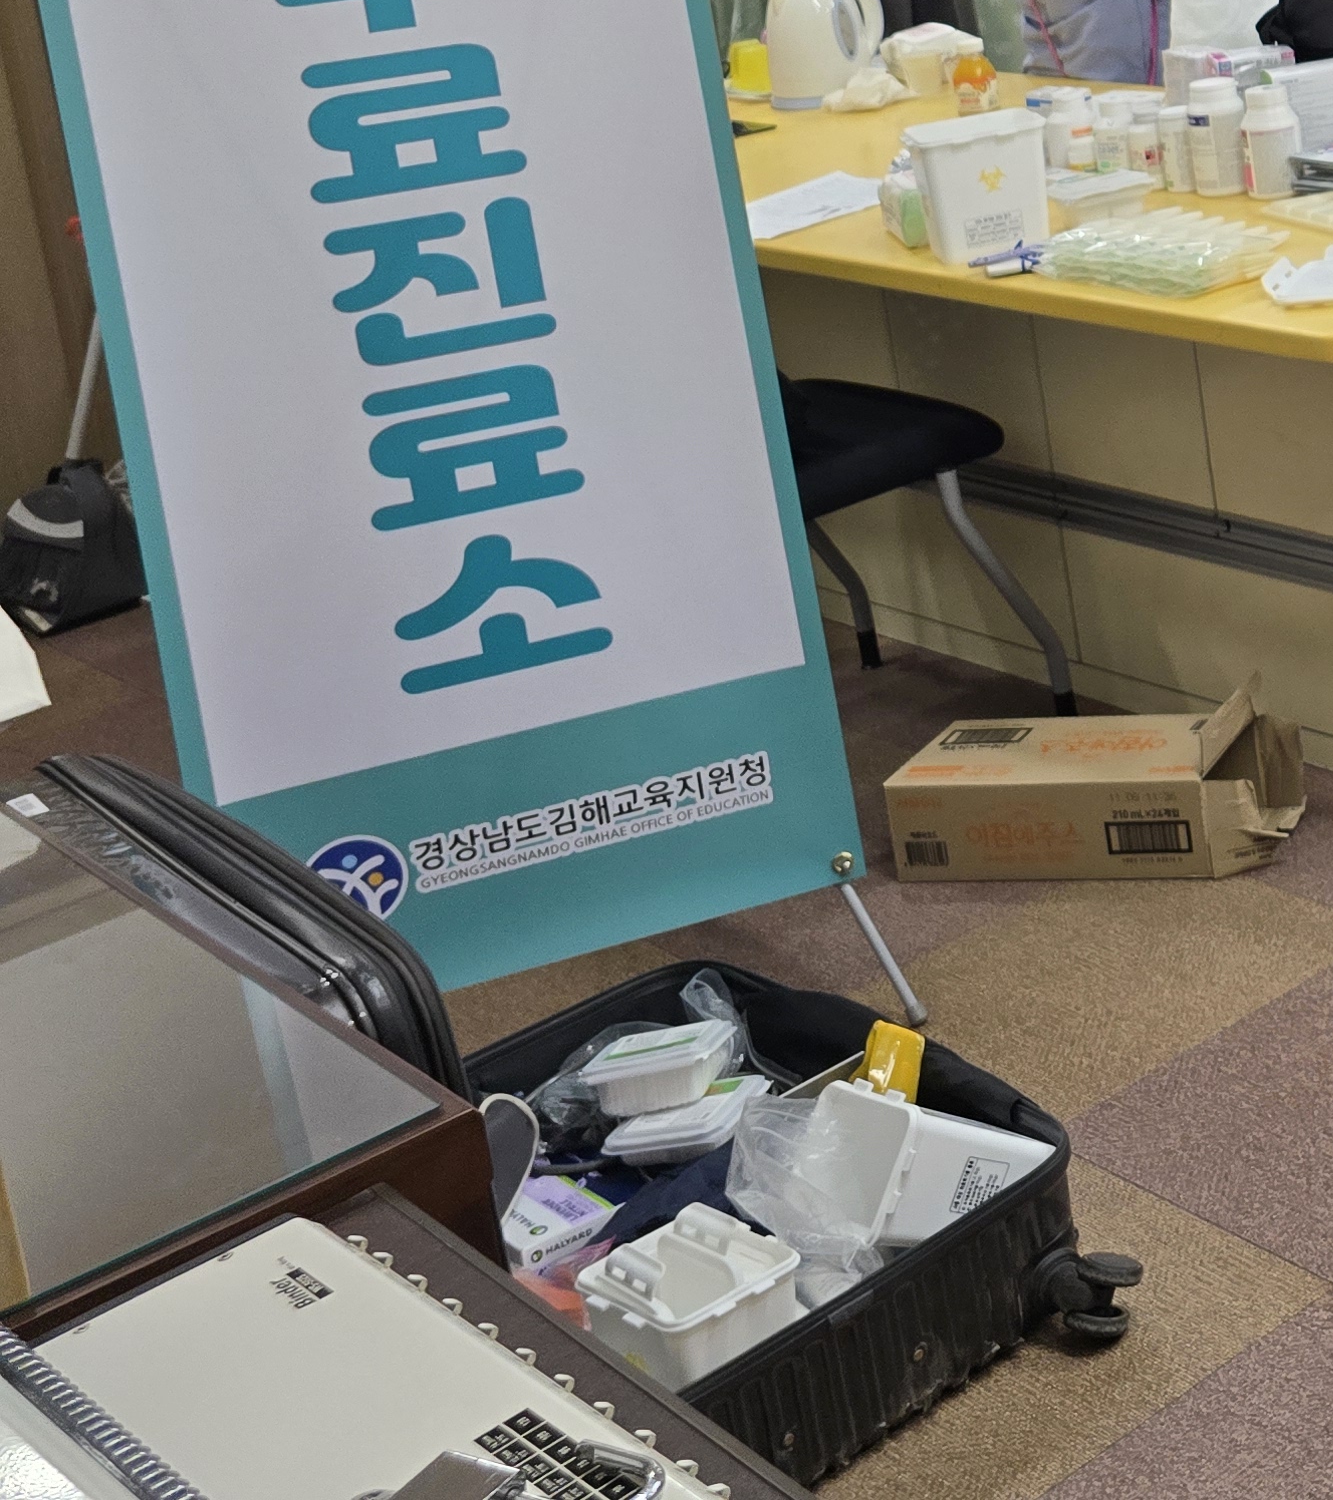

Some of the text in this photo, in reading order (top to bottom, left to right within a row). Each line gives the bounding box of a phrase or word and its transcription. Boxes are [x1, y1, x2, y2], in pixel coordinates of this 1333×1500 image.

[414, 755, 768, 871] 경상남도김해교육지원청
[419, 789, 770, 890] GYEONGSANGNAMDO GIMHAE OFFICE OF EDUCATION
[545, 1227, 593, 1255] HALYARD
[268, 1277, 317, 1310] Binder
